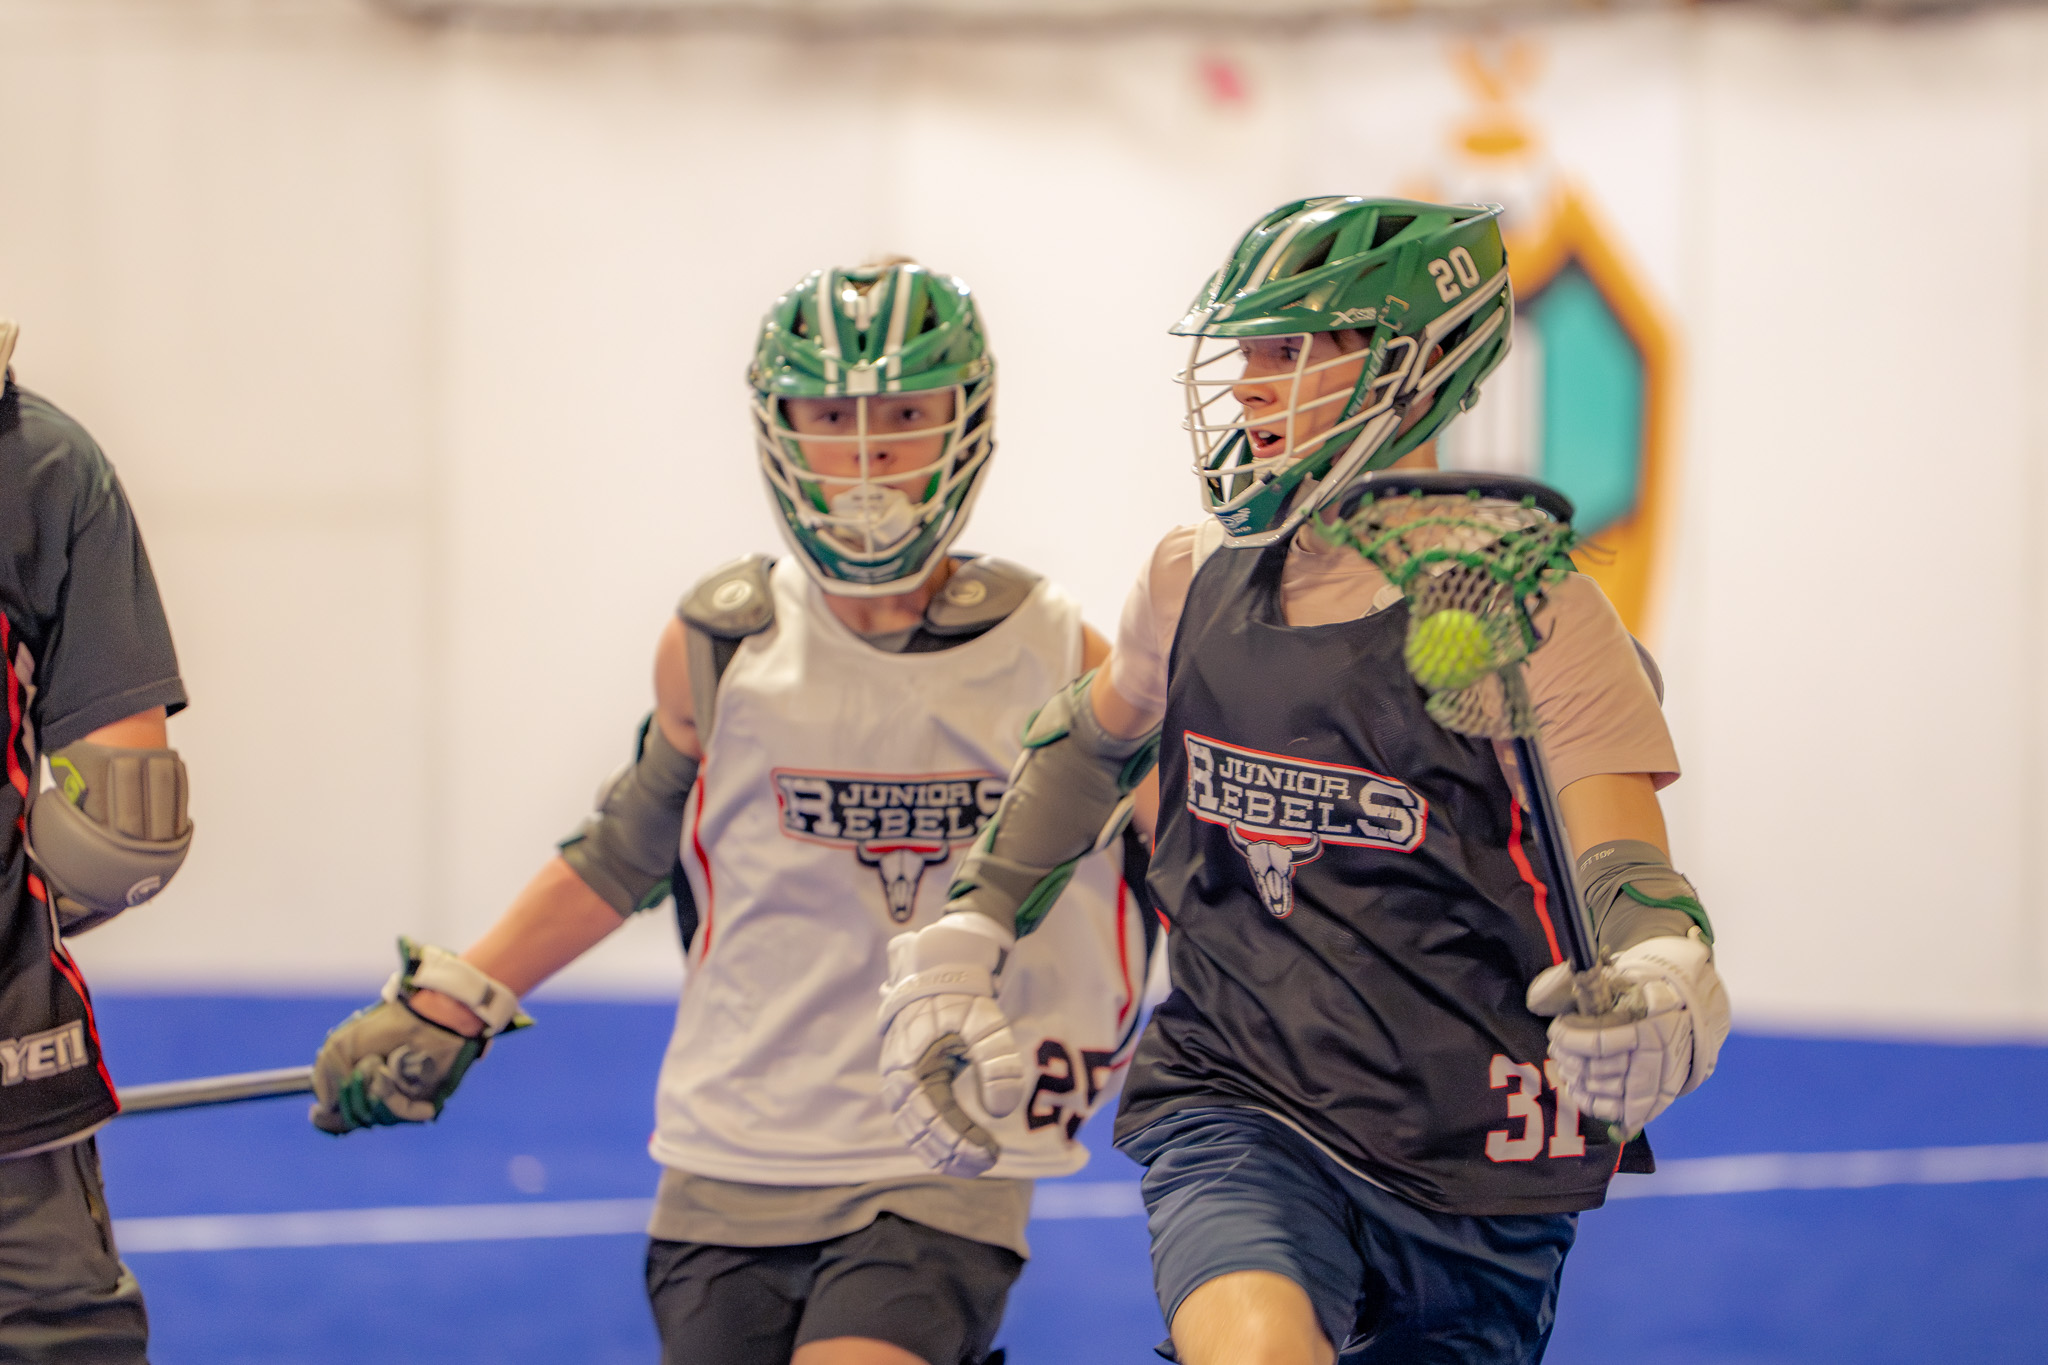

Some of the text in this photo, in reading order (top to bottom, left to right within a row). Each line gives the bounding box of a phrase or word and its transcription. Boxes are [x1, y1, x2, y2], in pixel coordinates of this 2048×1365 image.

[1427, 245, 1481, 304] 20
[837, 782, 974, 808] JUNIOR
[1187, 739, 1416, 843] REBELS
[1218, 755, 1352, 800] JUNIOR
[0, 1019, 88, 1086] YETI
[1484, 1053, 1586, 1163] 31
